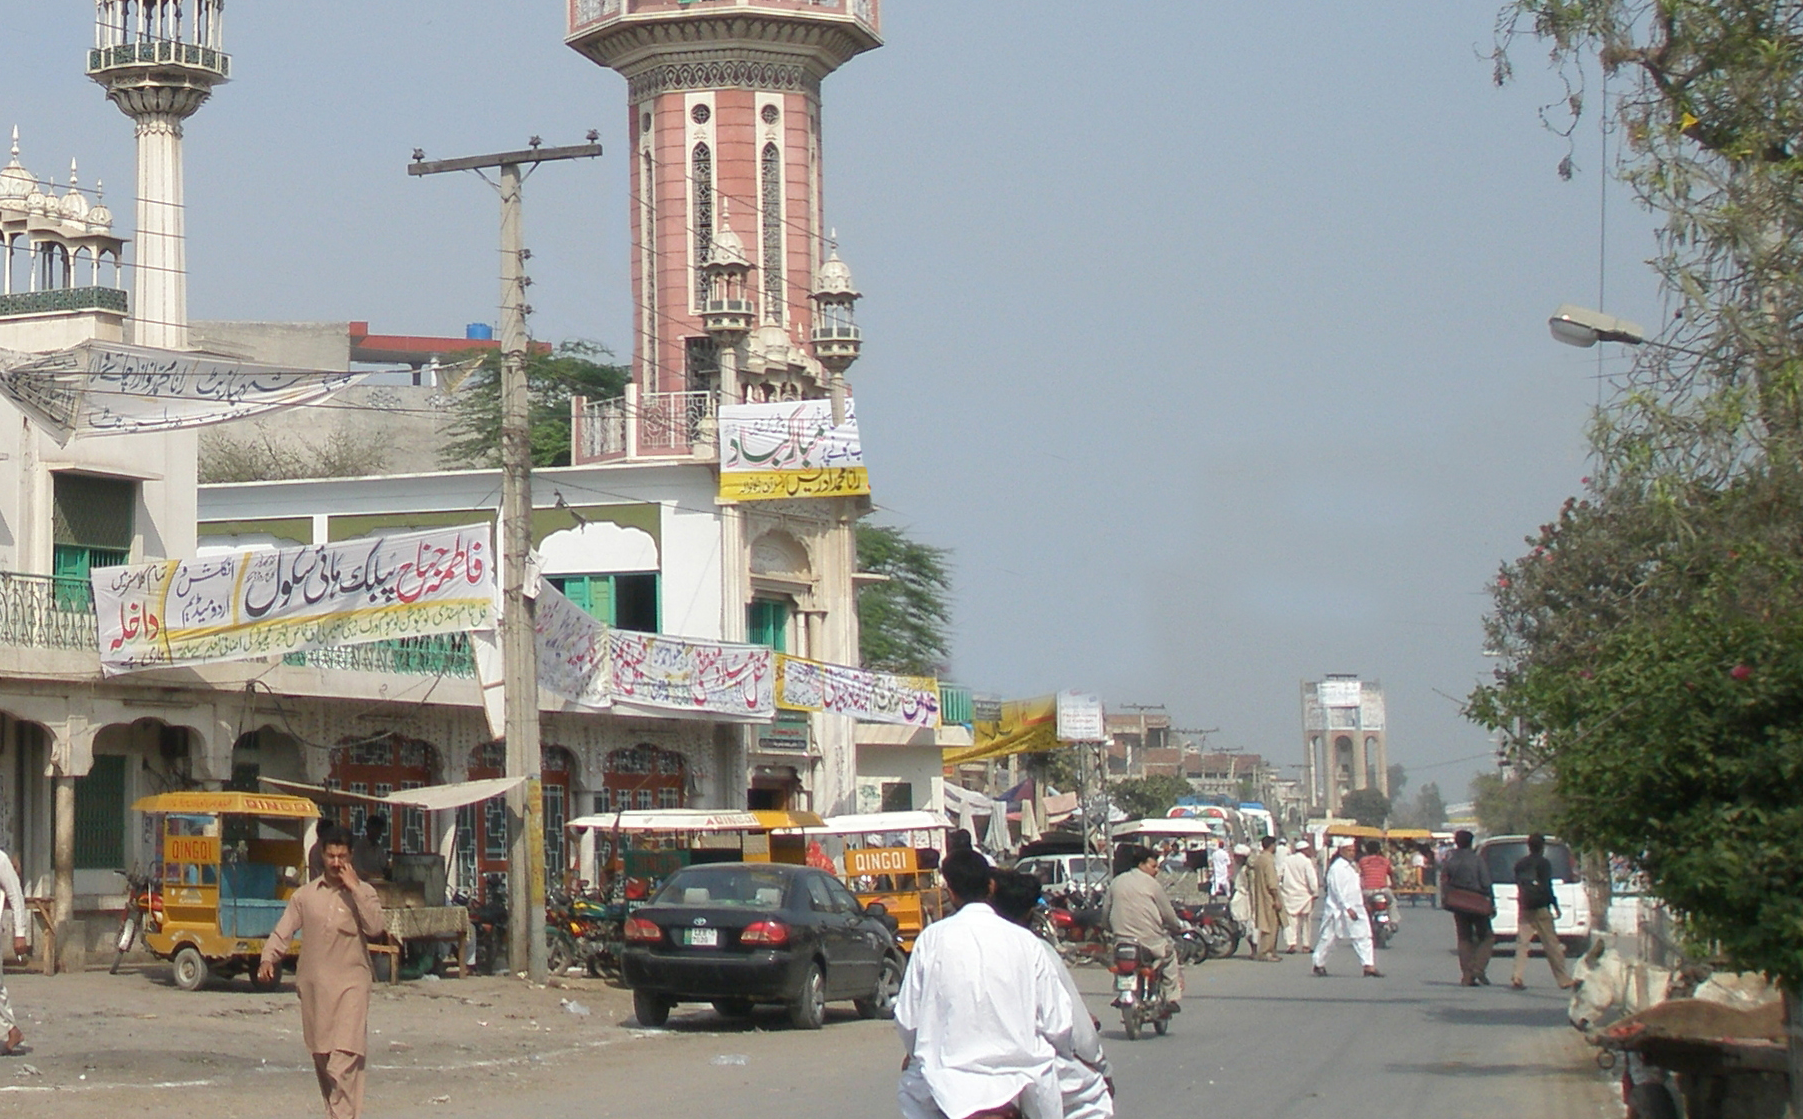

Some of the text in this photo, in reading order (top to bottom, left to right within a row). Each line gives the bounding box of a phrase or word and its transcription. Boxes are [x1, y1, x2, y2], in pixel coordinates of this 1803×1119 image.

[727, 404, 825, 471] مبارکباد
[147, 564, 167, 596] تمام
[245, 547, 315, 618] سکول
[304, 545, 343, 604] ہائی
[339, 538, 396, 603] پبلک
[396, 540, 449, 604] جناح
[425, 533, 483, 595] فاطمہ
[109, 600, 160, 652] داخلہ
[181, 591, 230, 629] اردو میڈیم
[244, 798, 313, 812] QINGQI
[172, 840, 212, 860] QINGQI
[855, 852, 908, 871] QINGQI
